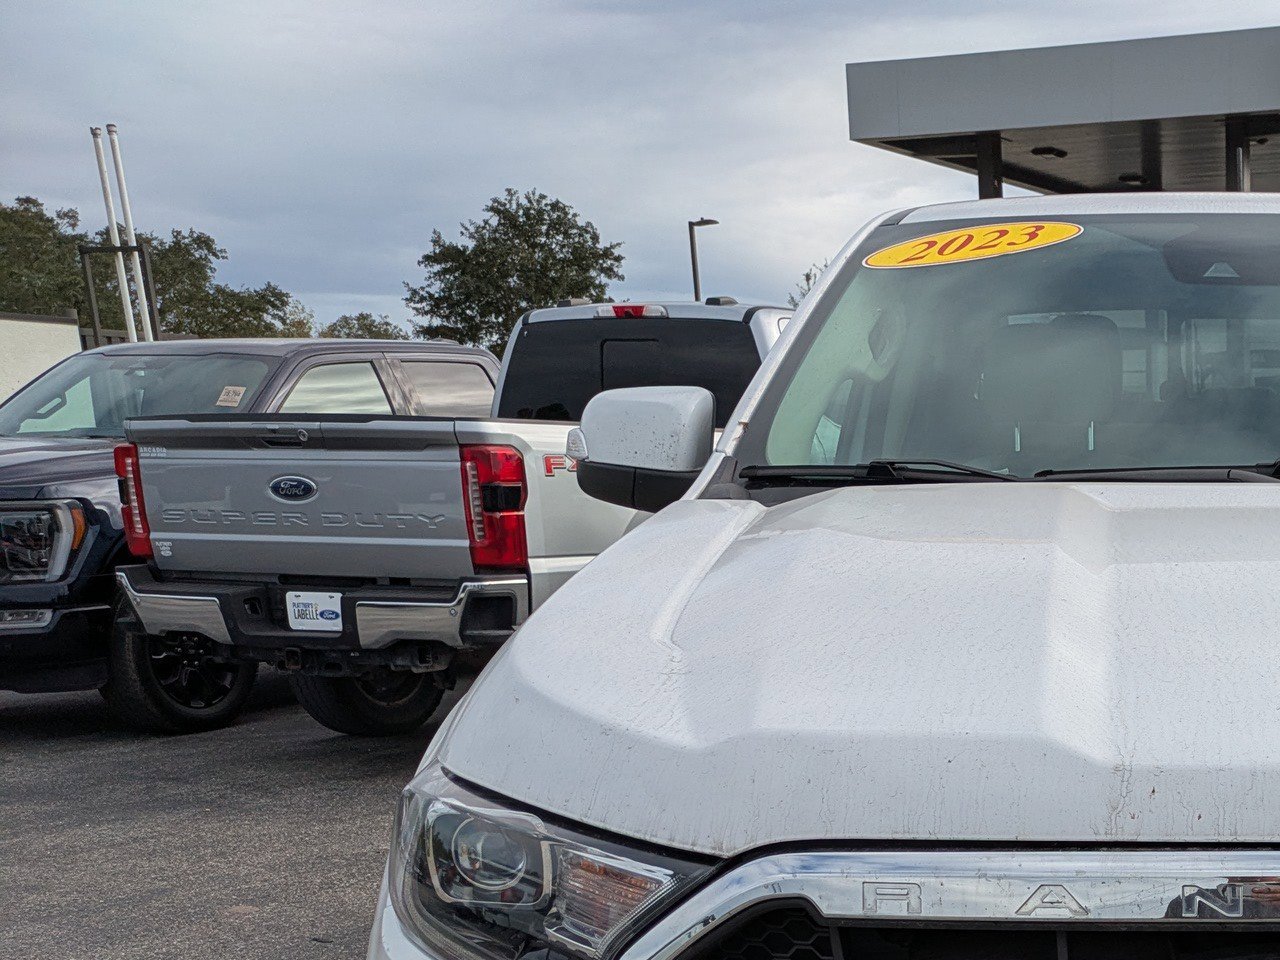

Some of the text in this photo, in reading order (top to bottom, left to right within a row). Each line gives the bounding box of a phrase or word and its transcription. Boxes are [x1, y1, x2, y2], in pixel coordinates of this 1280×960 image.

[897, 225, 1045, 264] 2023
[279, 480, 305, 496] Ford
[161, 507, 446, 529] SUPER DUTY
[293, 609, 320, 620] LABELLE
